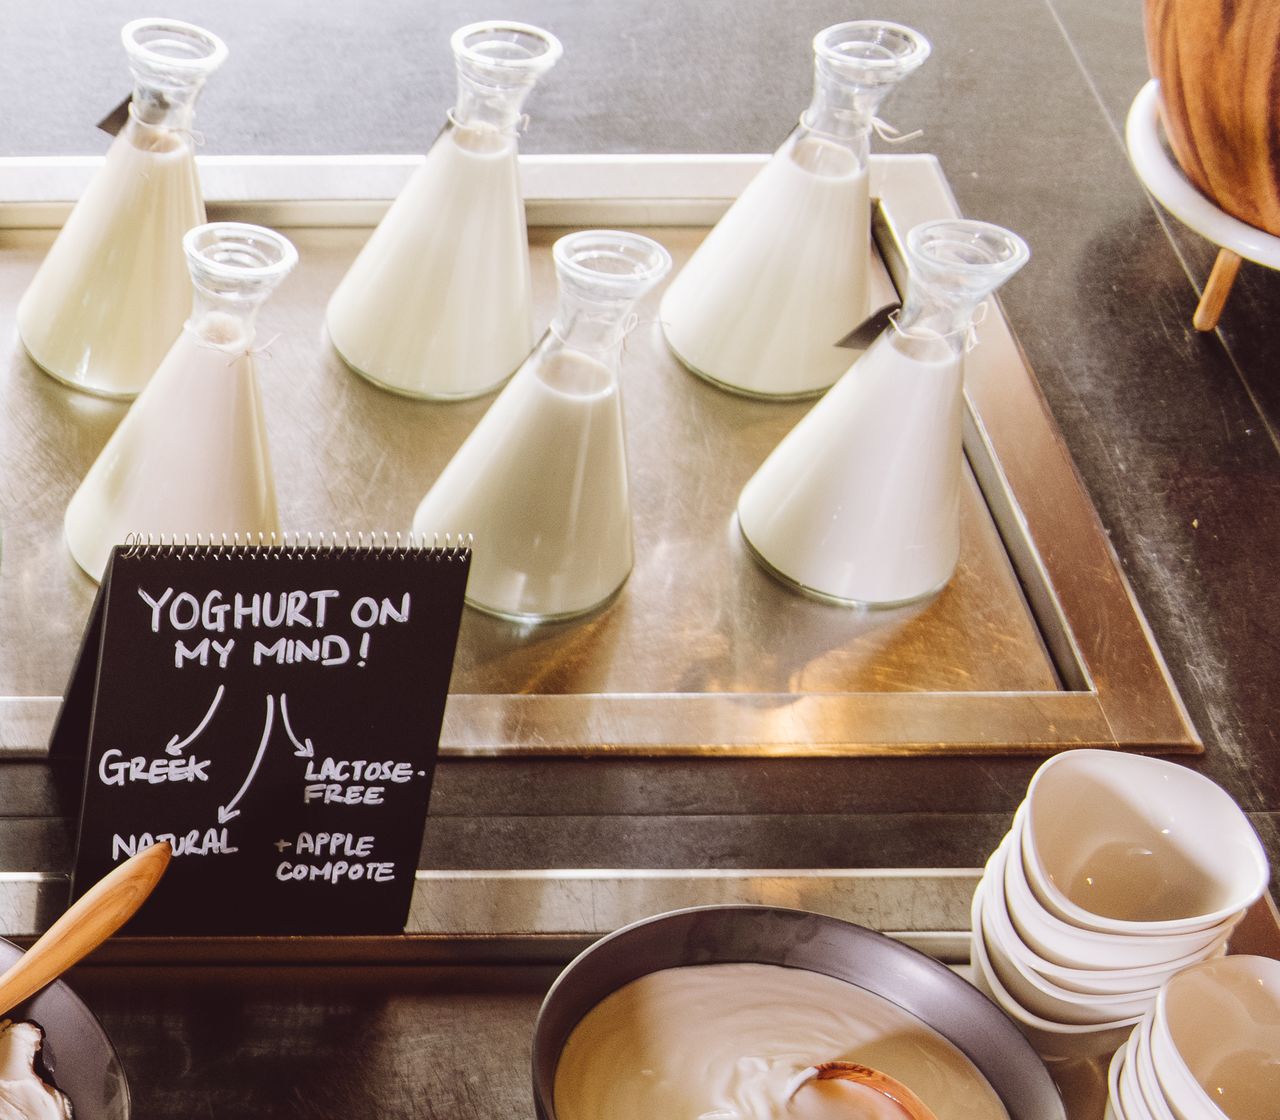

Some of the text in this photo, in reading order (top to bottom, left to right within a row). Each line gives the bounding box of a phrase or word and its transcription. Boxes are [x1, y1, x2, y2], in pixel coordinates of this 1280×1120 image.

[138, 586, 410, 632] YOGHURT ON
[174, 638, 235, 668] MY
[98, 749, 211, 786] GREEK
[303, 784, 385, 804] FREE
[296, 831, 375, 857] APPLE
[275, 861, 395, 884] COMPOTE
